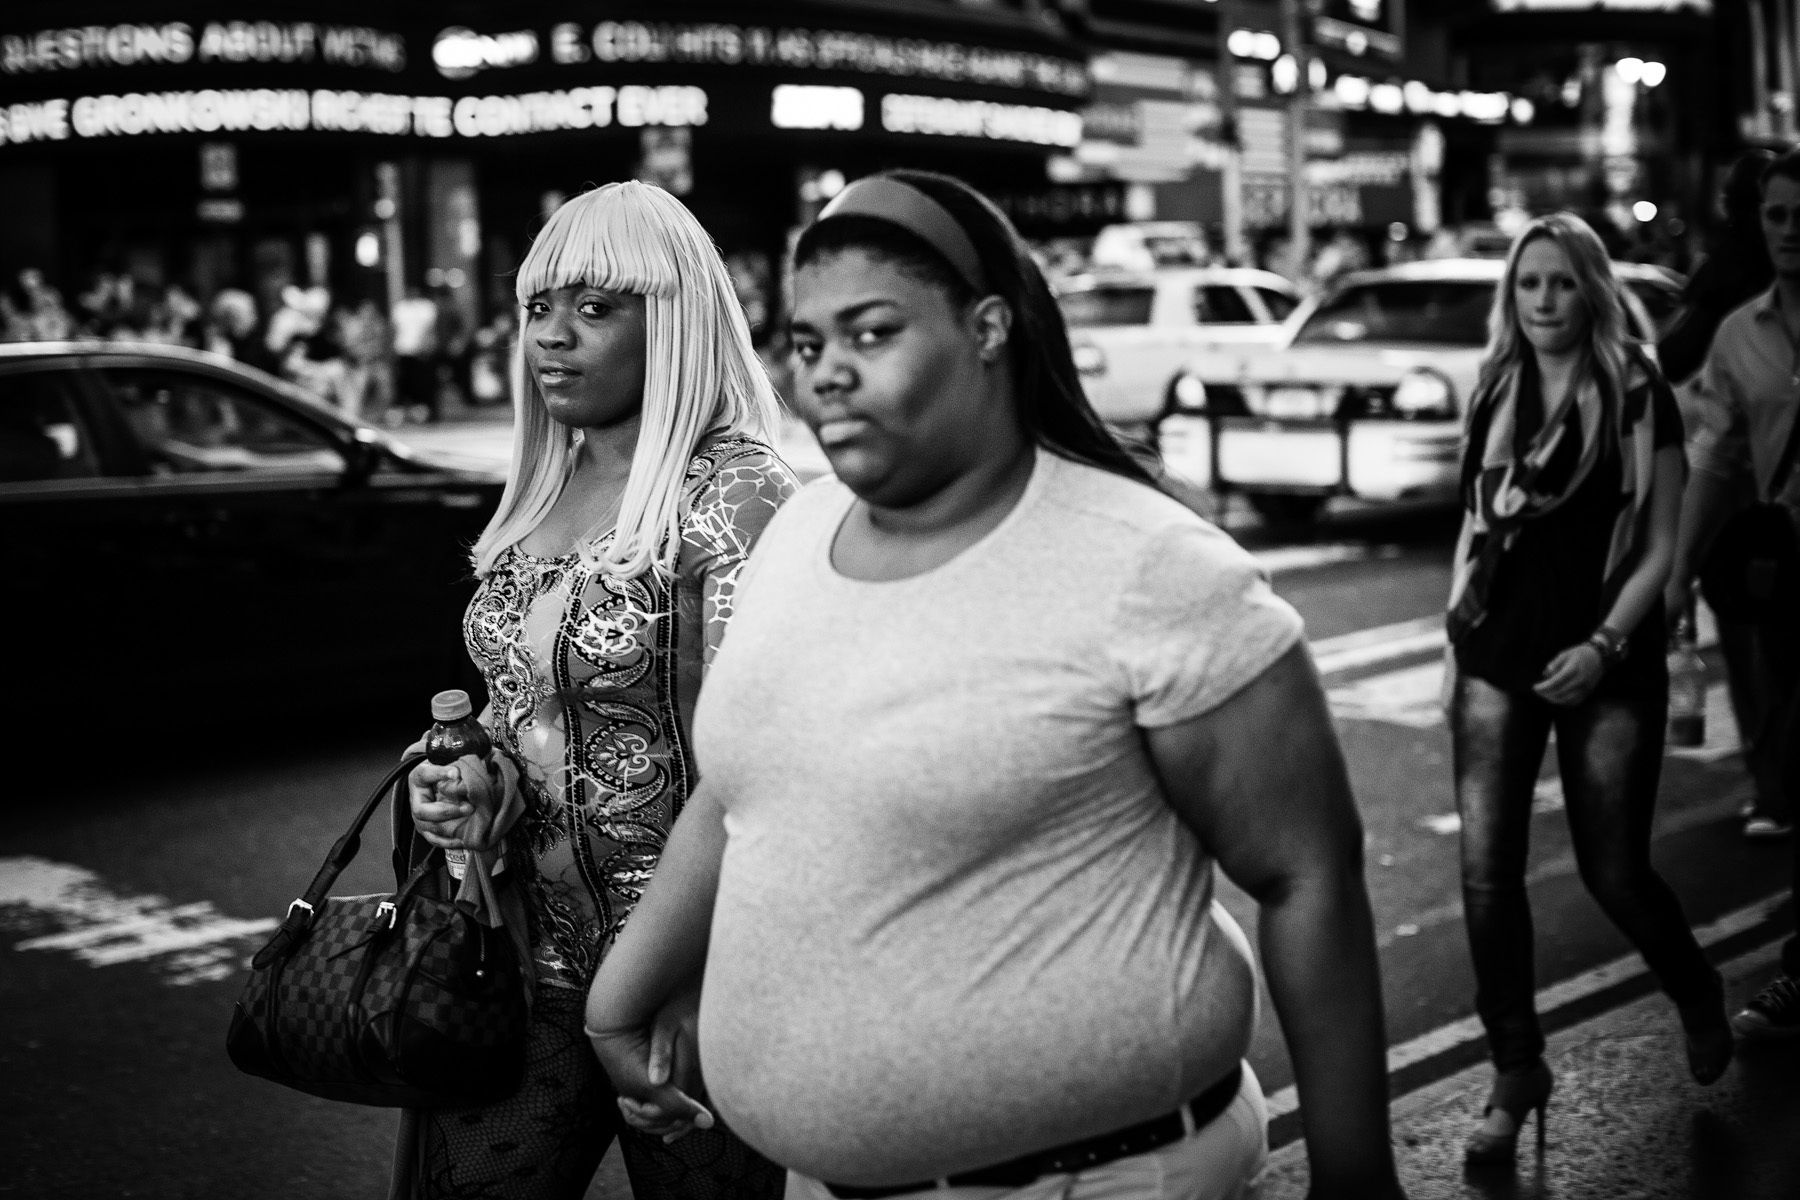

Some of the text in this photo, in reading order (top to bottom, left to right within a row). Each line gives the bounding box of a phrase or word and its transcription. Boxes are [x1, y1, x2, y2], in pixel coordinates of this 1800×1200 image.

[201, 21, 315, 63] ABOUT
[72, 89, 309, 137] GRONKOWSKI
[453, 86, 616, 137] CONTRACT
[617, 85, 708, 127] EVER
